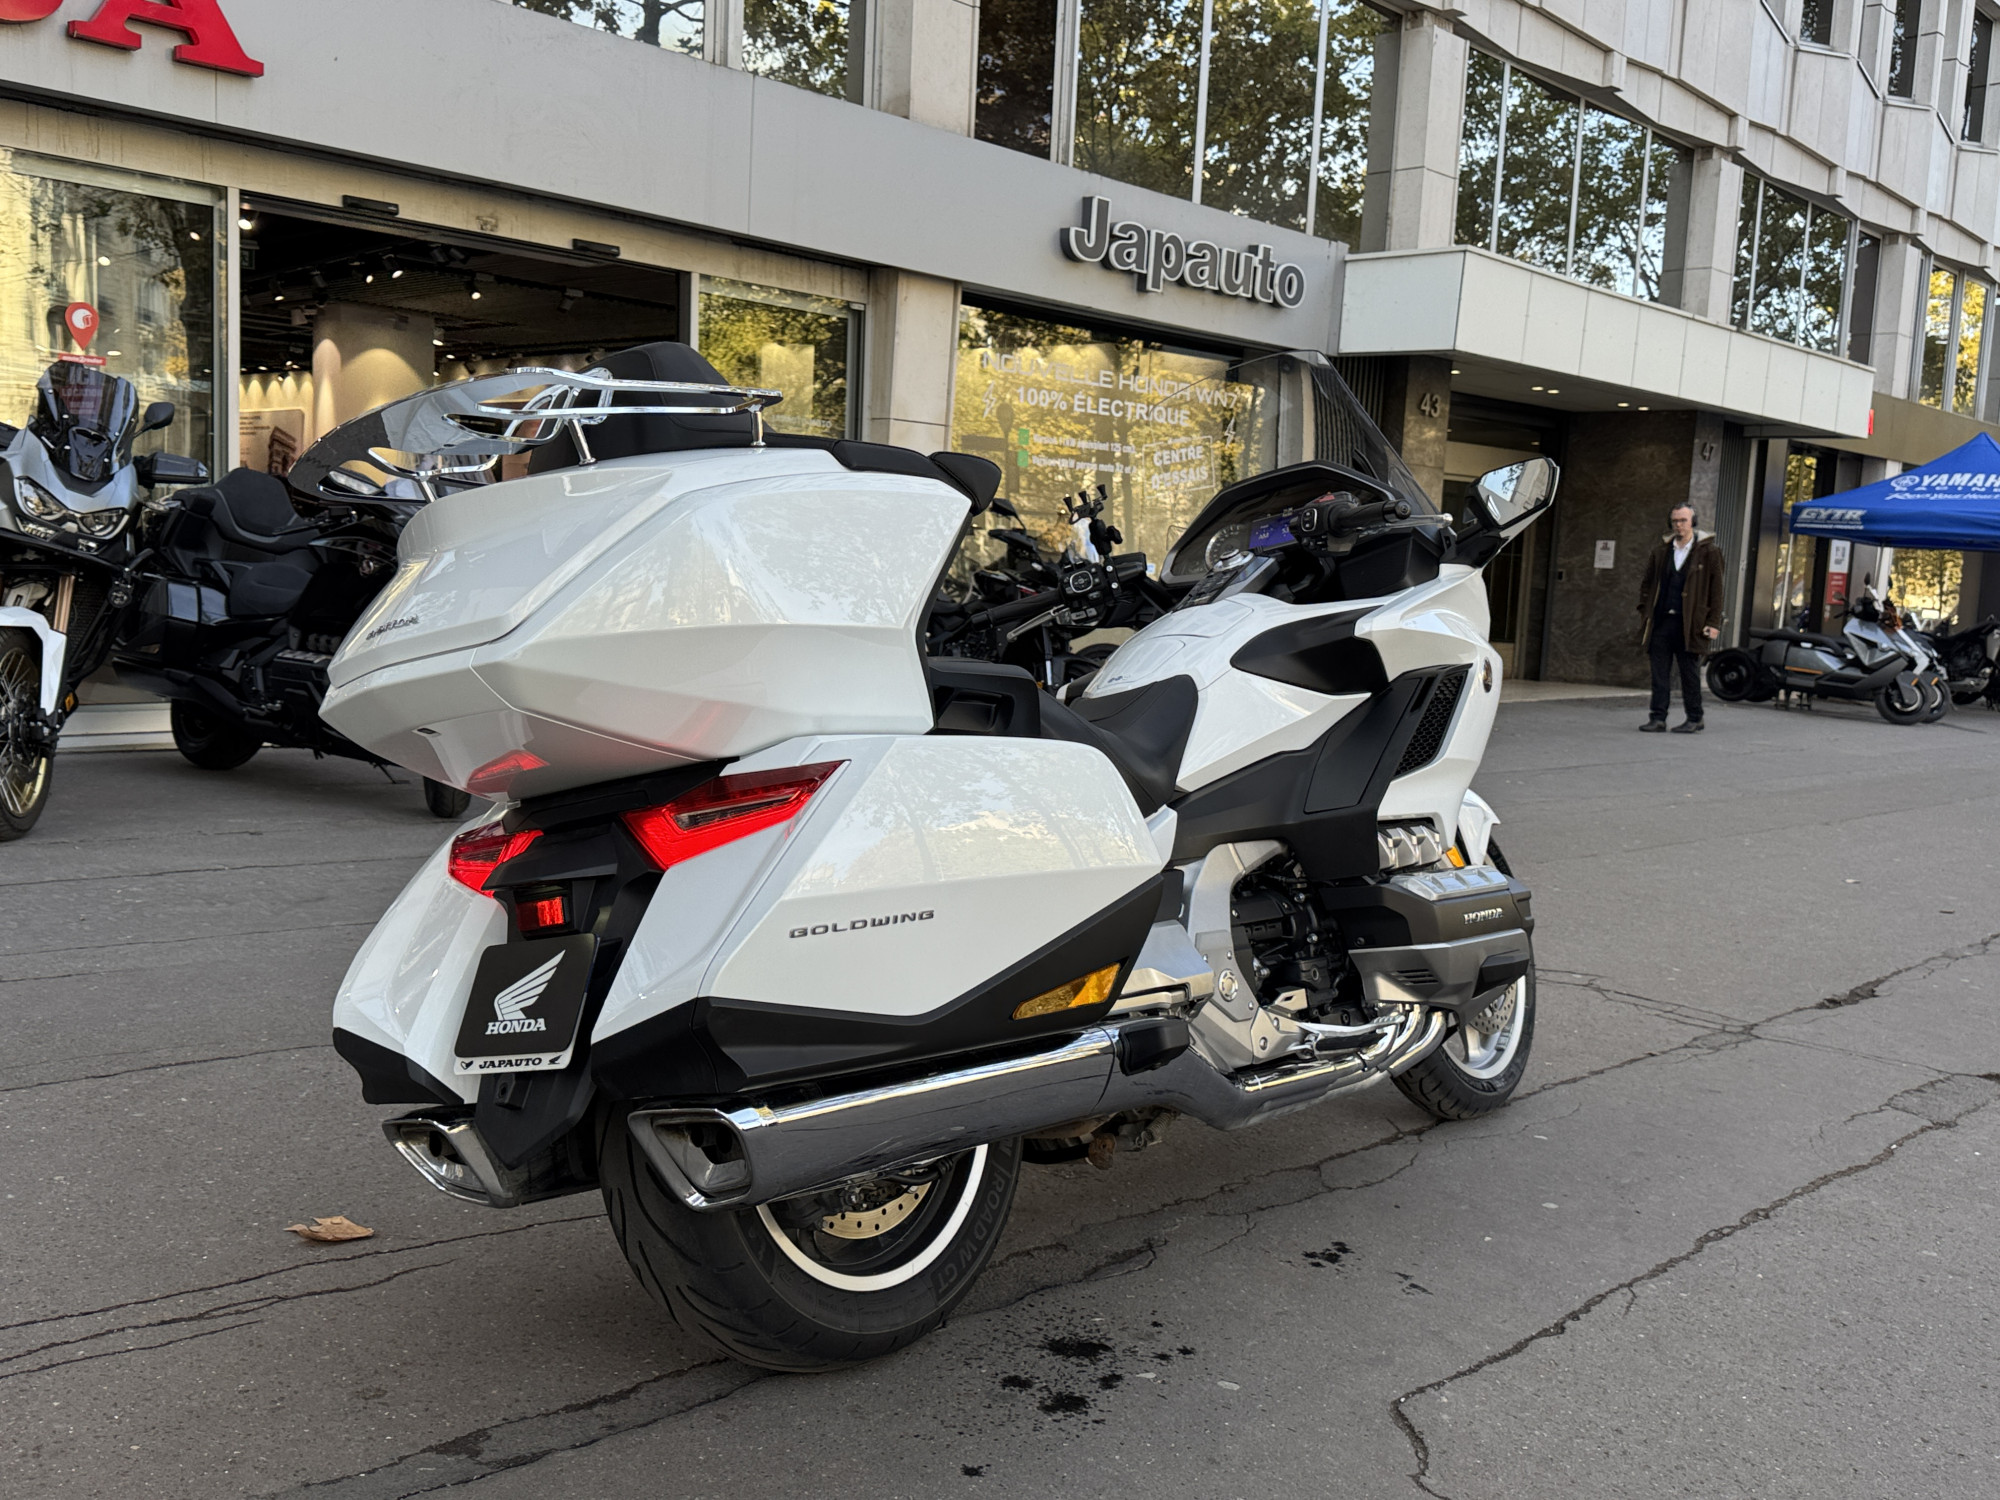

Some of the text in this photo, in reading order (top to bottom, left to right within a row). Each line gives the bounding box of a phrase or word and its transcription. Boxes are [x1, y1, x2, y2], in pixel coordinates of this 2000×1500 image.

[1064, 195, 1306, 309] Japauto
[982, 351, 1237, 409] NOUVELLE HONDA WN7
[1016, 385, 1191, 427] 100% ÉLECTRIQUE
[1420, 392, 1441, 418] 43
[1153, 445, 1204, 467] CENTRE
[1799, 508, 1868, 521] GYTR
[789, 910, 934, 938] GOLDWING
[1463, 907, 1504, 925] HONDA
[485, 1018, 546, 1035] HONDA
[479, 1057, 542, 1069] JAPAUTO
